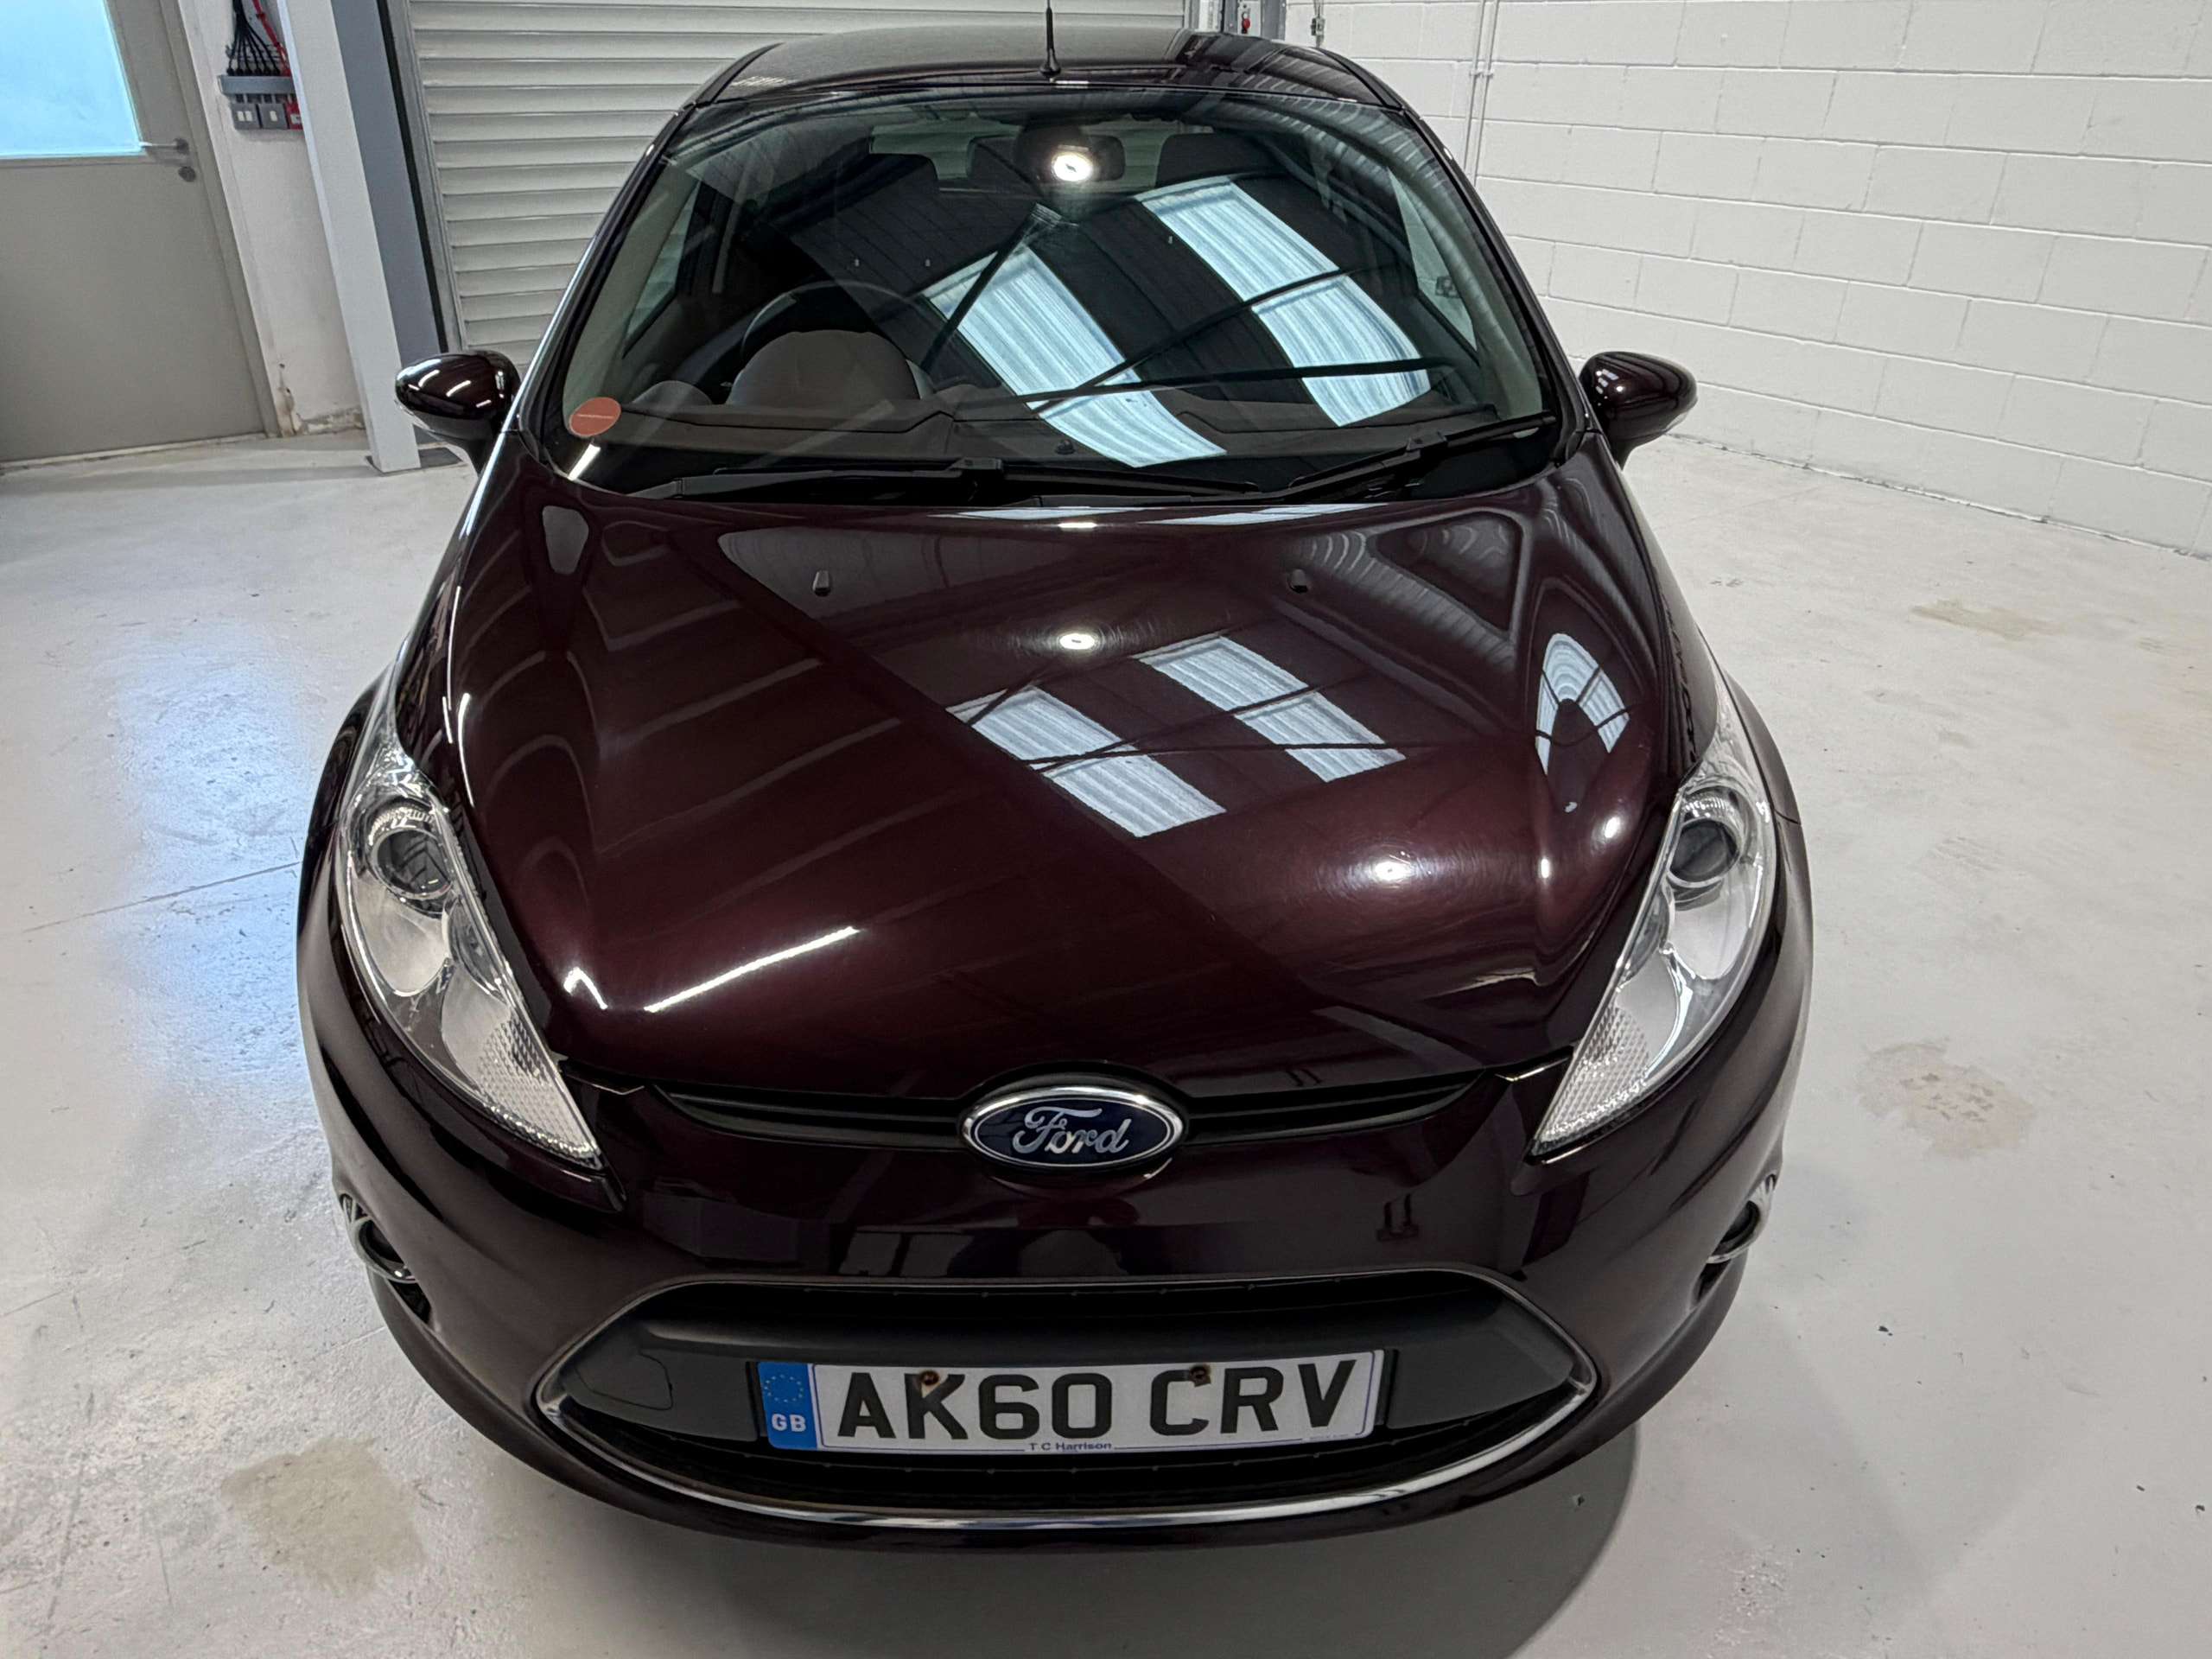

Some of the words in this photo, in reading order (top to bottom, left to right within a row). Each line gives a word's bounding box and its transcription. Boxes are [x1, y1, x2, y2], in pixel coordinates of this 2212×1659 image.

[1012, 1106, 1132, 1154] Ford
[837, 1371, 1112, 1440] AK60
[1150, 1359, 1357, 1437] CRV
[771, 1413, 806, 1433] GB
[1029, 1442, 1038, 1451] T
[1041, 1442, 1052, 1451] C
[1056, 1442, 1112, 1452] Harrison
